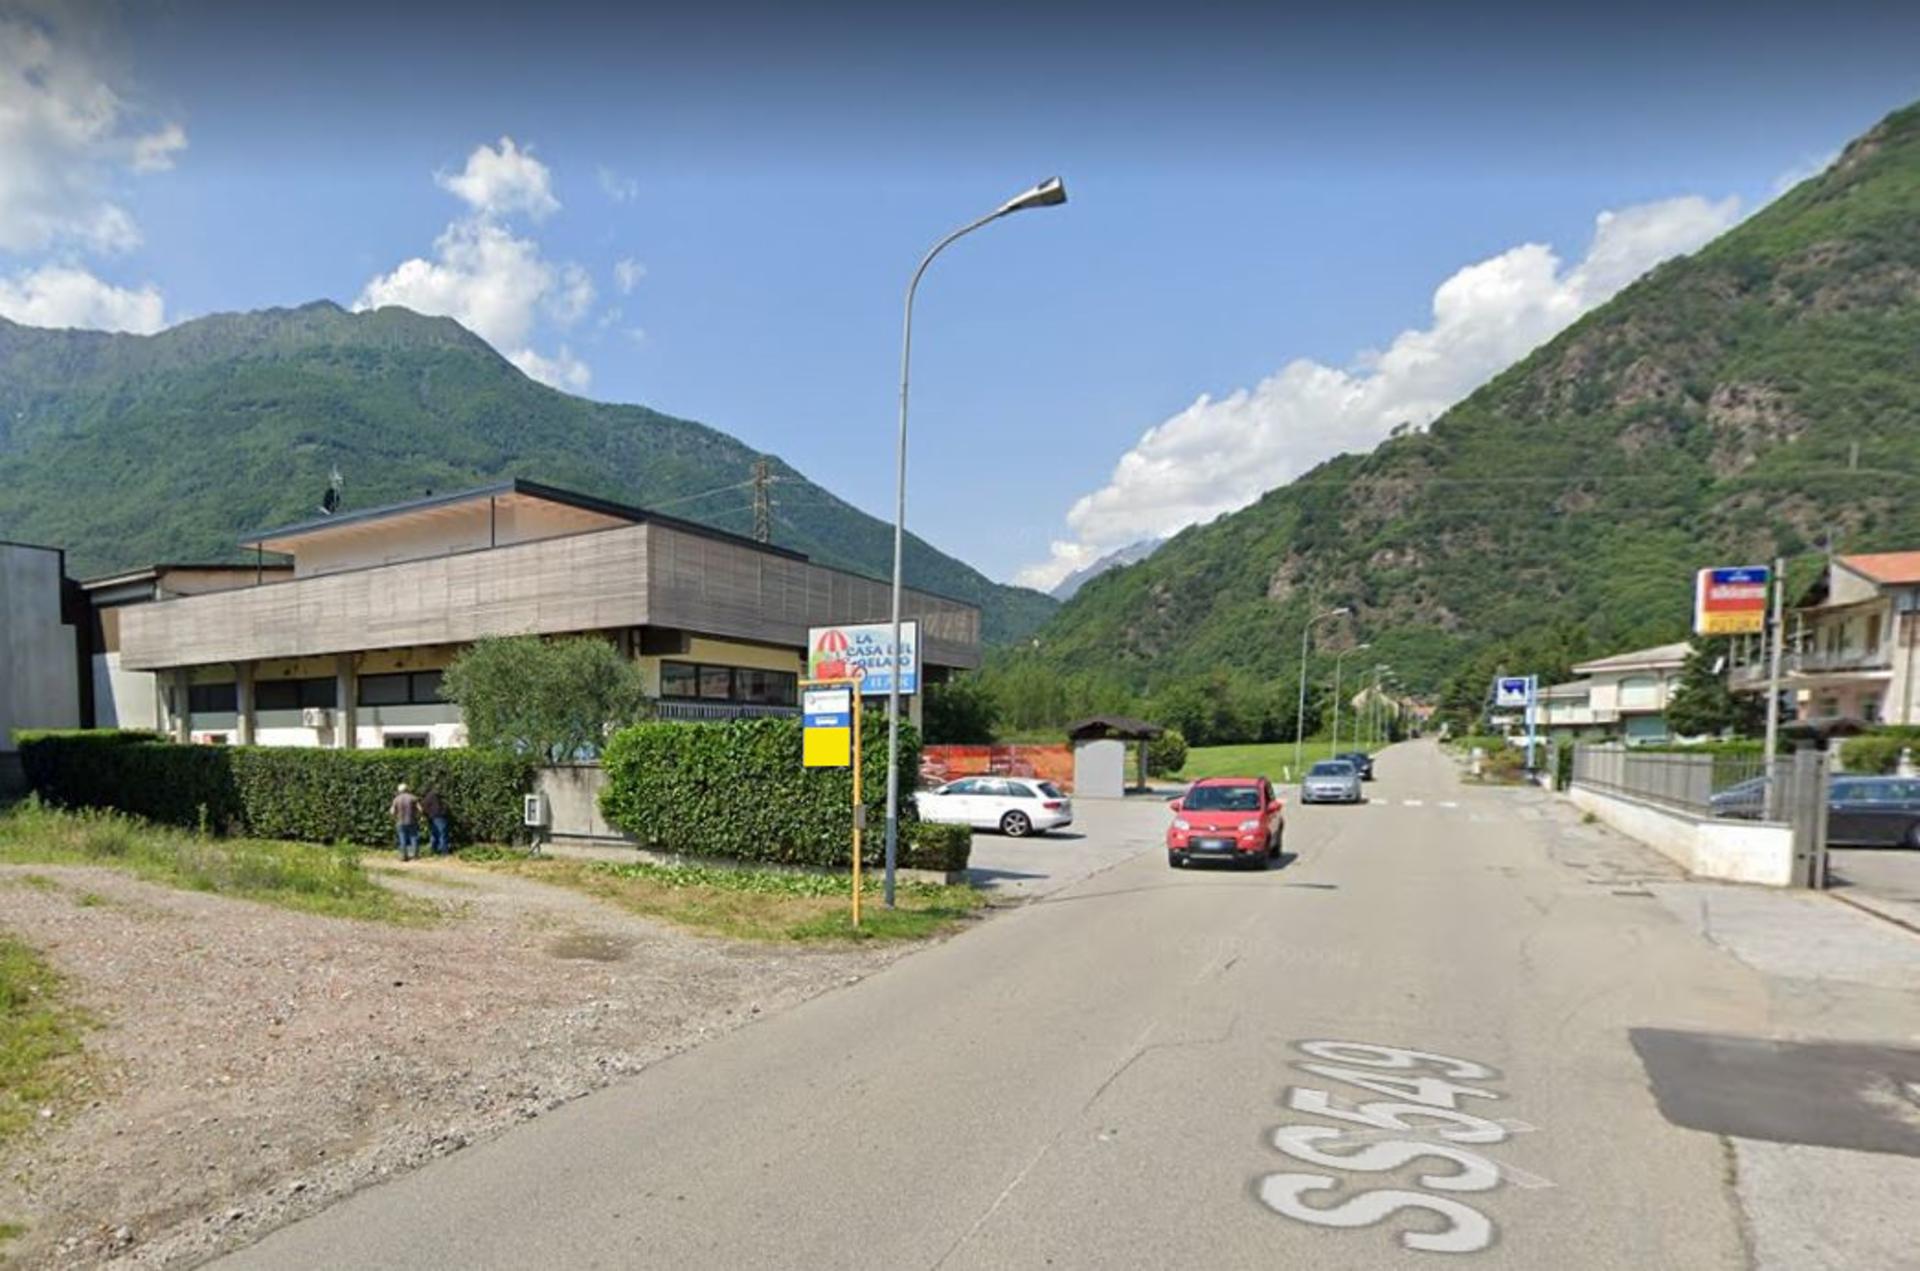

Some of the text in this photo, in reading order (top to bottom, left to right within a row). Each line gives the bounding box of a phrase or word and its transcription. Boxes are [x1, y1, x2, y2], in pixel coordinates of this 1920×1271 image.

[855, 634, 872, 644] LA
[846, 646, 882, 656] CASA
[857, 656, 910, 667] GELAO
[1260, 1040, 1505, 1252] SS549
